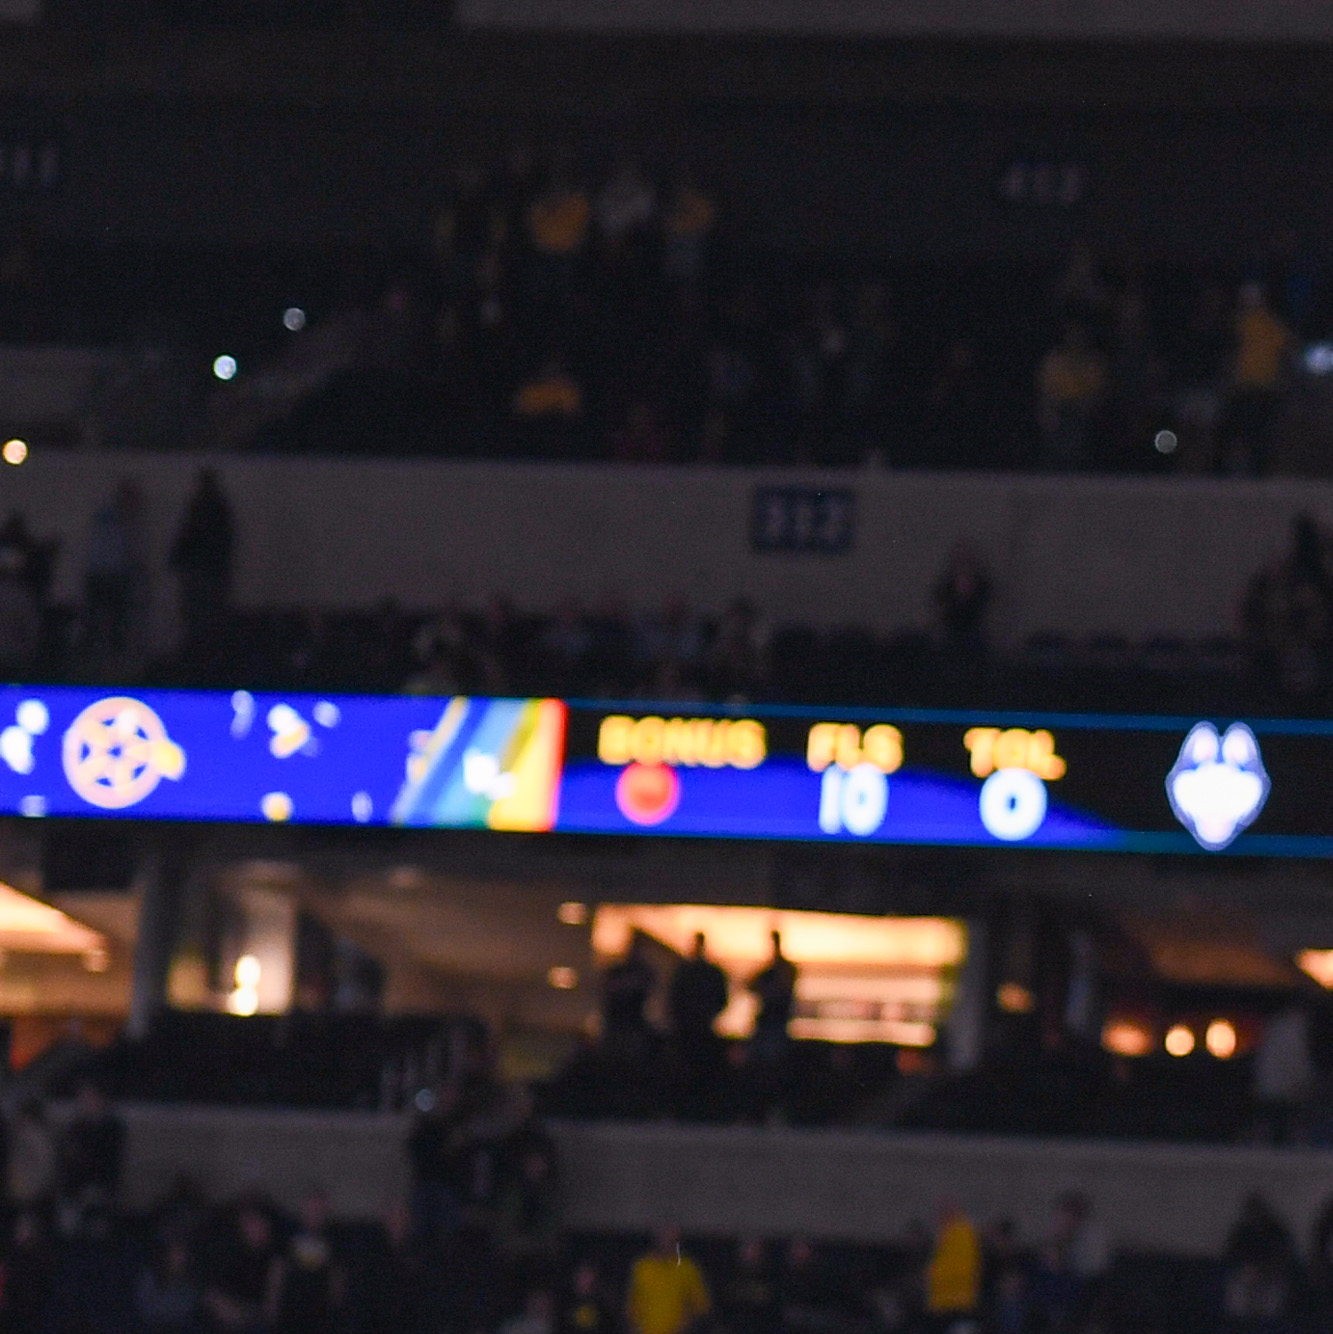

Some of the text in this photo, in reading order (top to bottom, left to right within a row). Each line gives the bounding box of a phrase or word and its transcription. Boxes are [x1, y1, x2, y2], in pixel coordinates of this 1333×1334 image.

[598, 715, 767, 769] BONUS
[807, 722, 904, 774] FLS
[819, 762, 888, 836] 10
[979, 767, 1048, 841] 0
